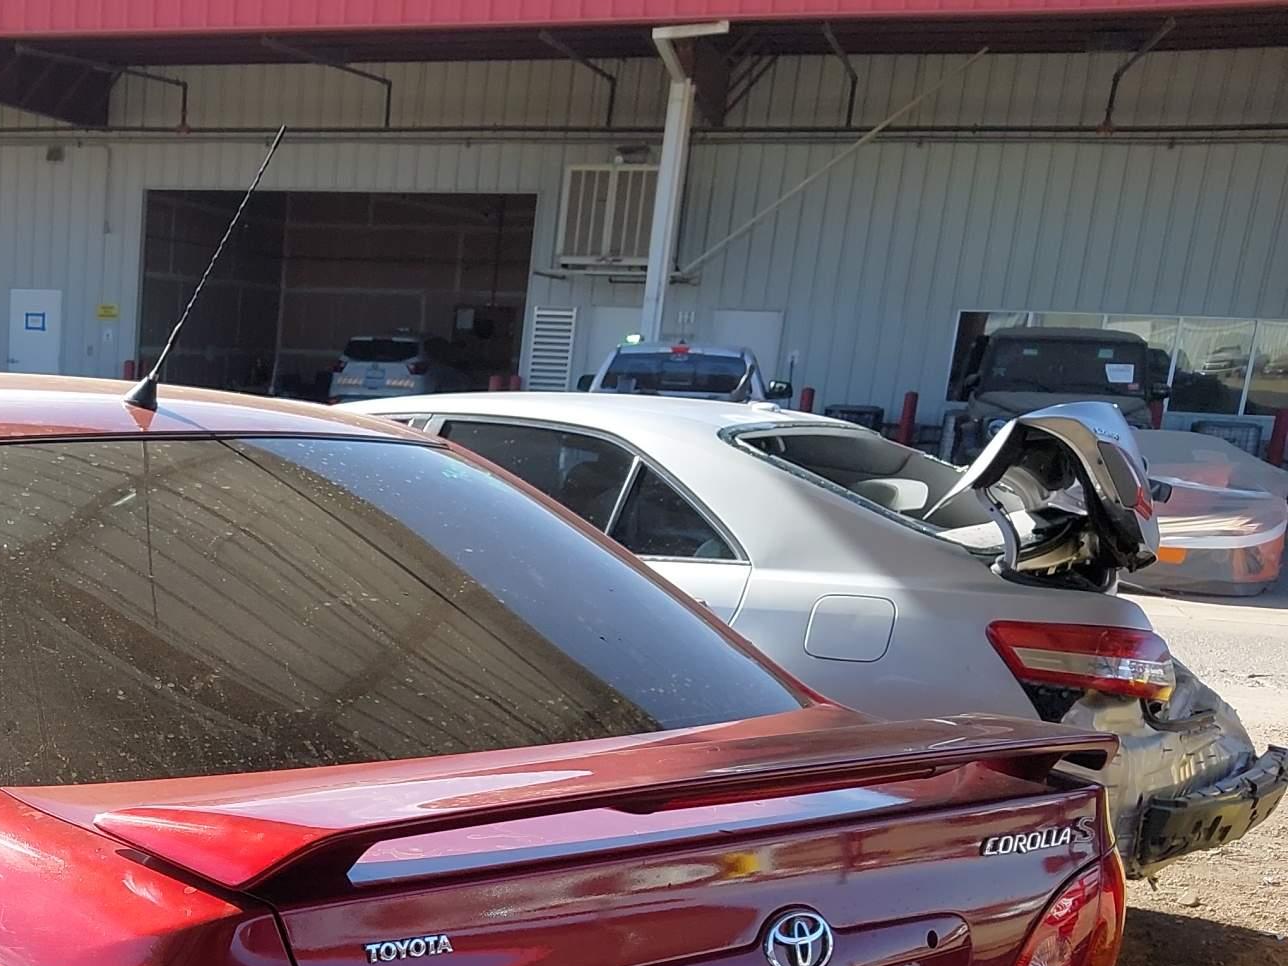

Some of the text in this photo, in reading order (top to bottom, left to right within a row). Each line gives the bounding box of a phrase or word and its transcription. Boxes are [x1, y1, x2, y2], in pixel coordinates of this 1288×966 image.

[984, 816, 1095, 855] COROLLA S
[365, 935, 454, 963] TOYOTA
